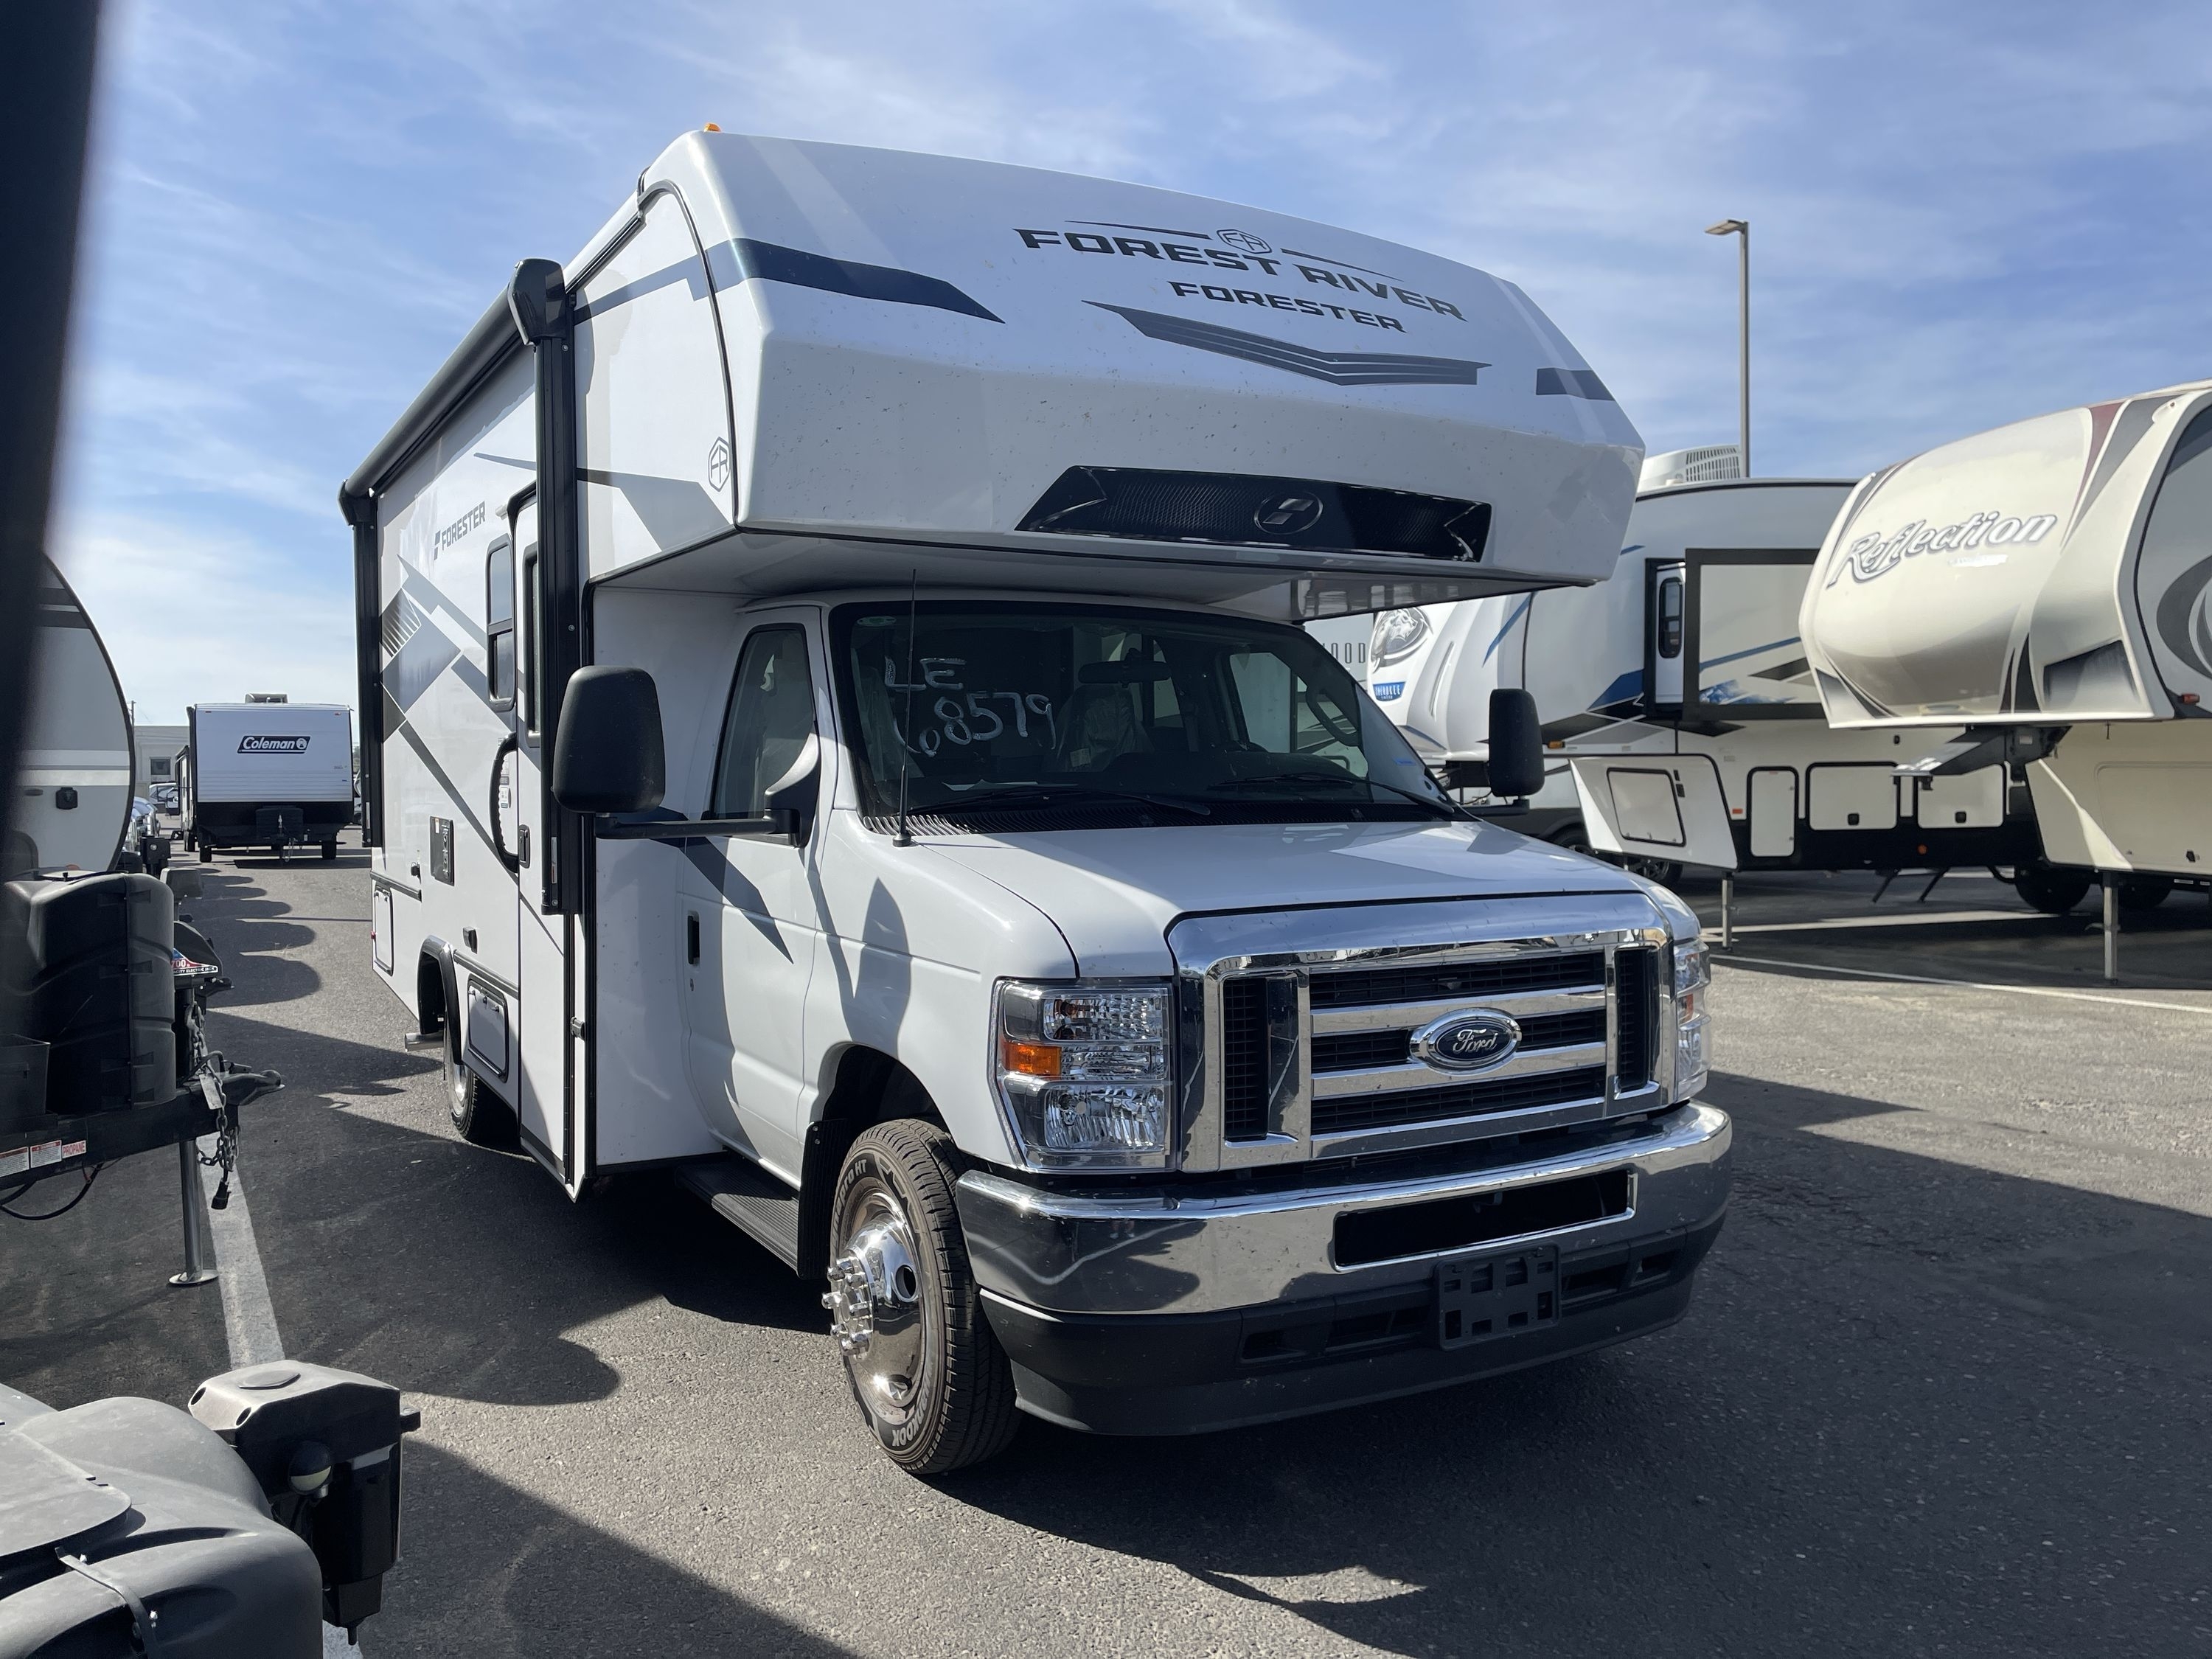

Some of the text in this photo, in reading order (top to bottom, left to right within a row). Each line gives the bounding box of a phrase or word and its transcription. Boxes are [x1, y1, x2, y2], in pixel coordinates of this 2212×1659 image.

[1012, 228, 1469, 323] FOREST RIVER
[1167, 280, 1408, 334] FORESTER
[441, 501, 486, 551] FORESTER
[1826, 510, 2058, 590] Reflection
[1322, 642, 1366, 664] OOD
[884, 655, 966, 692] LE
[243, 736, 296, 750] Coleman
[1452, 1028, 1499, 1054] Ford
[63, 1142, 85, 1157] PROPANE
